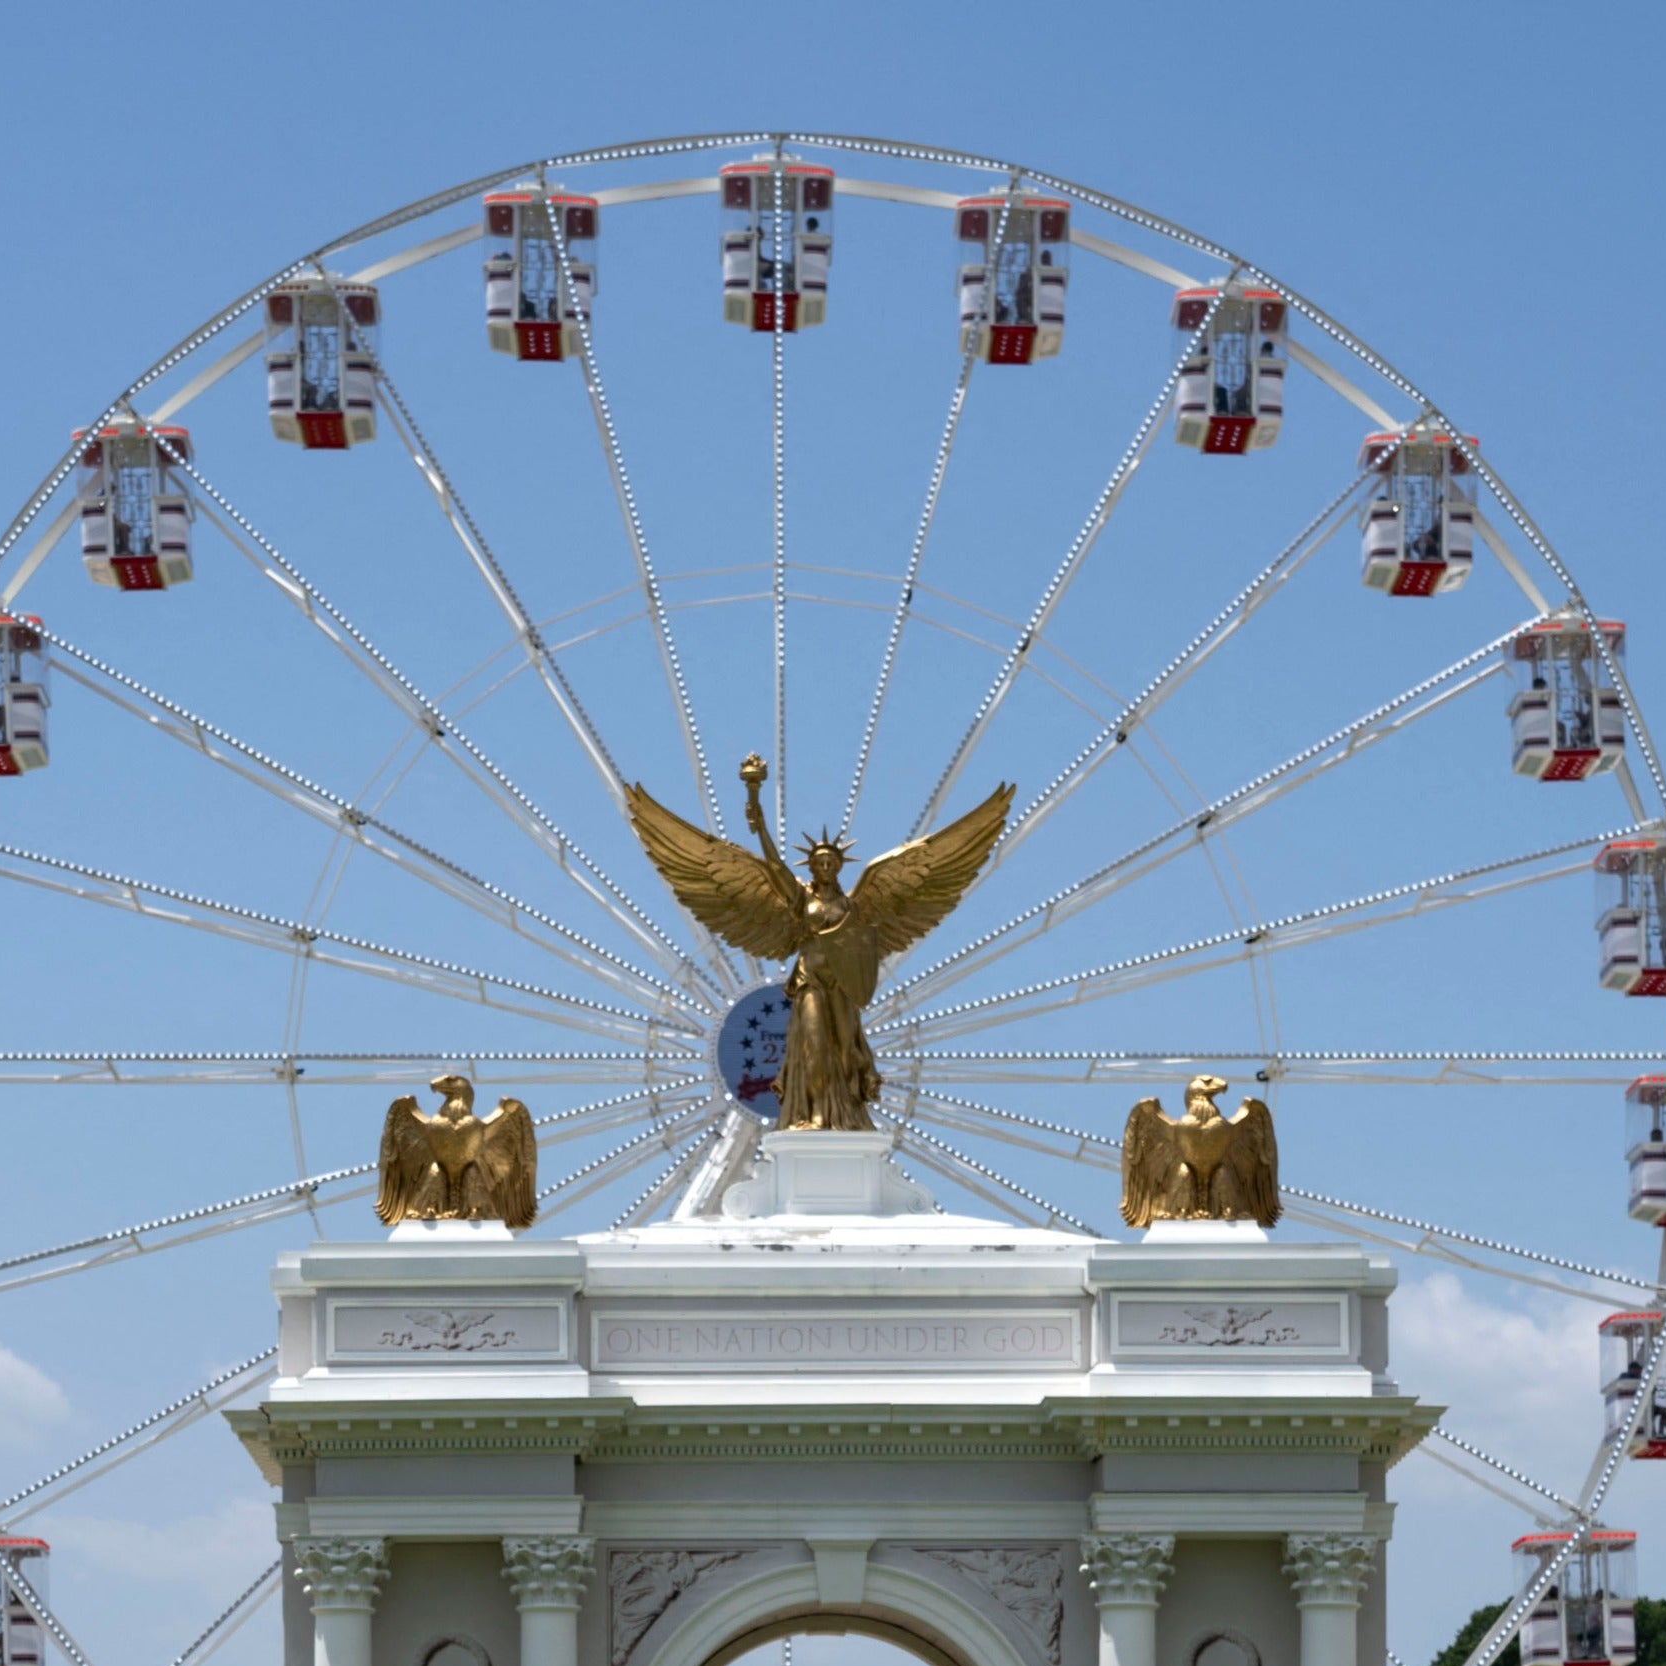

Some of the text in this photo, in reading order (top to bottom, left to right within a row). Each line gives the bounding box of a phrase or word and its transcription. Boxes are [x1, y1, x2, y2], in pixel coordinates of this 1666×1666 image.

[606, 1326, 1065, 1354] ONE NATION UNDER GOD
